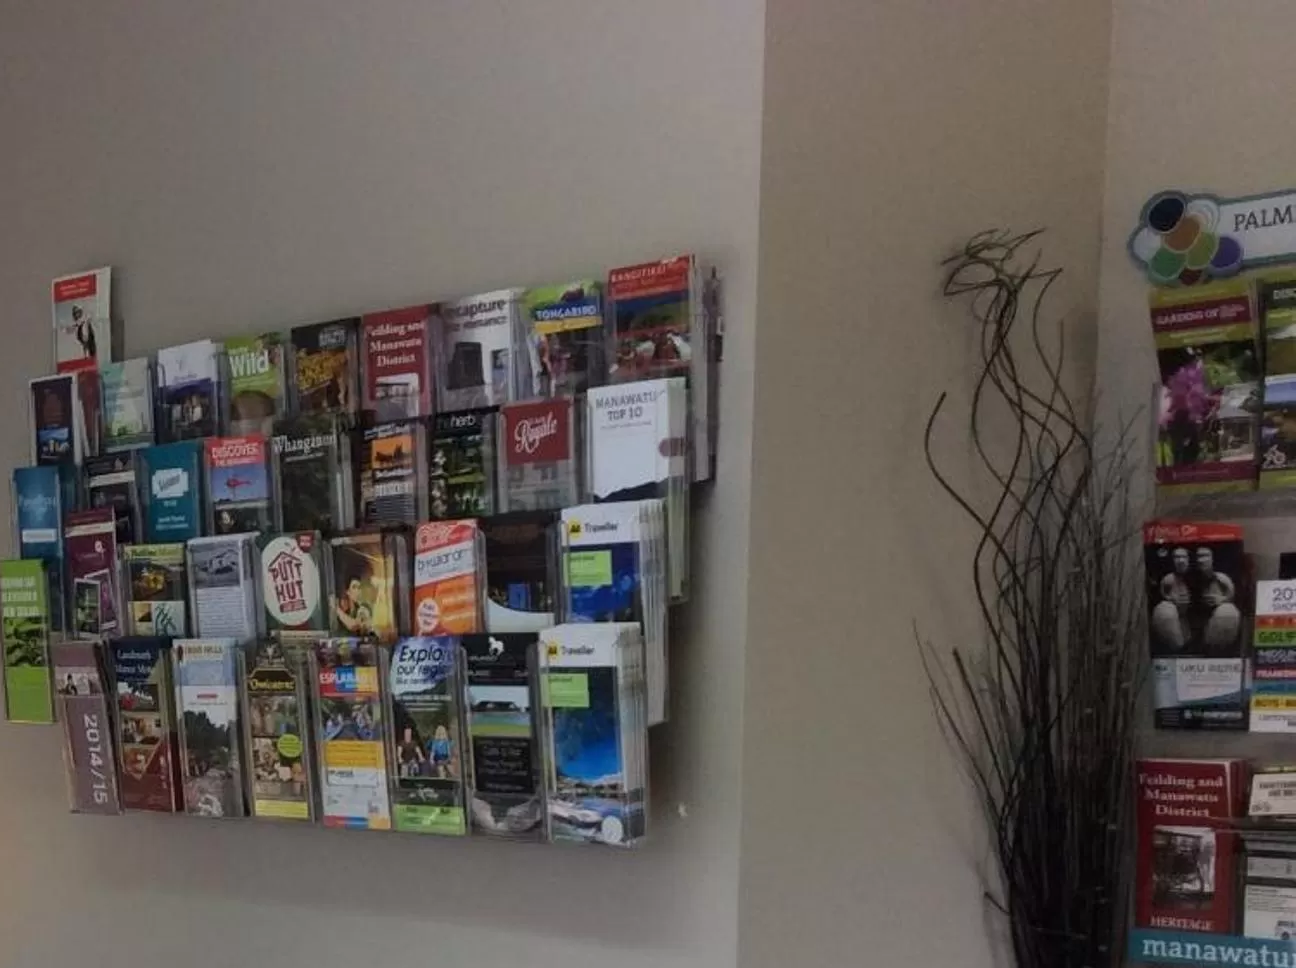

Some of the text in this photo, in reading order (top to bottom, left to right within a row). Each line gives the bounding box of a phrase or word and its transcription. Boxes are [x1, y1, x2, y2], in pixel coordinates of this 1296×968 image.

[1234, 204, 1296, 232] PALM
[268, 559, 303, 583] PUTT
[275, 580, 304, 603] HUT
[83, 713, 109, 805] 2014/15
[1155, 804, 1210, 818] District
[1150, 915, 1214, 931] HERITAGE
